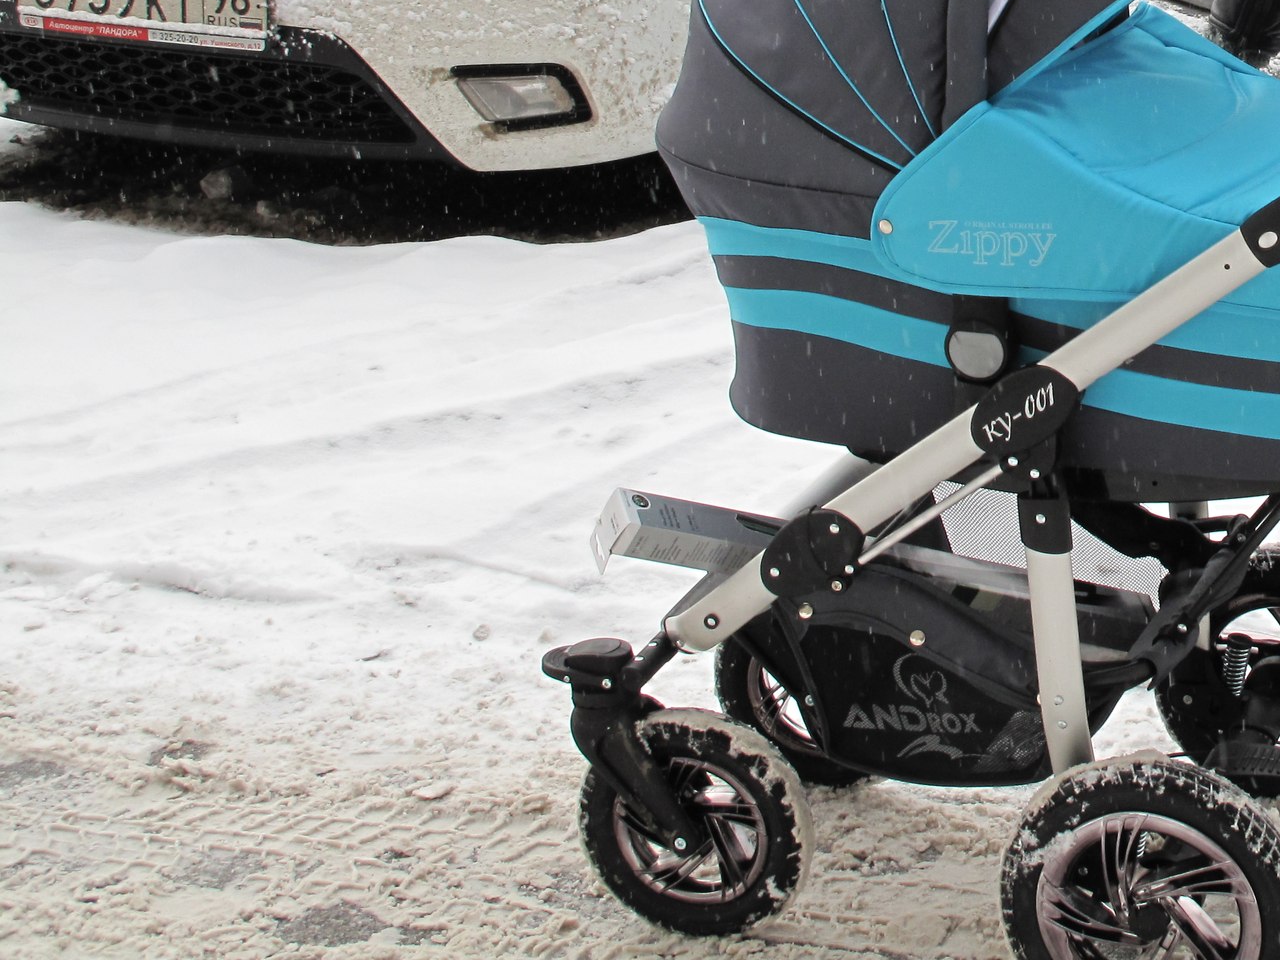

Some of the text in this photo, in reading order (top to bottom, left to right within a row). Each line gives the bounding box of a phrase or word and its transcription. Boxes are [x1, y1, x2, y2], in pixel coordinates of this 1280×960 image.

[48, 21, 94, 33] Автоцентр
[207, 15, 237, 27] RUS
[159, 32, 199, 44] 325-20-20
[927, 220, 1057, 267] Zippy
[842, 702, 982, 734] ANDROX
